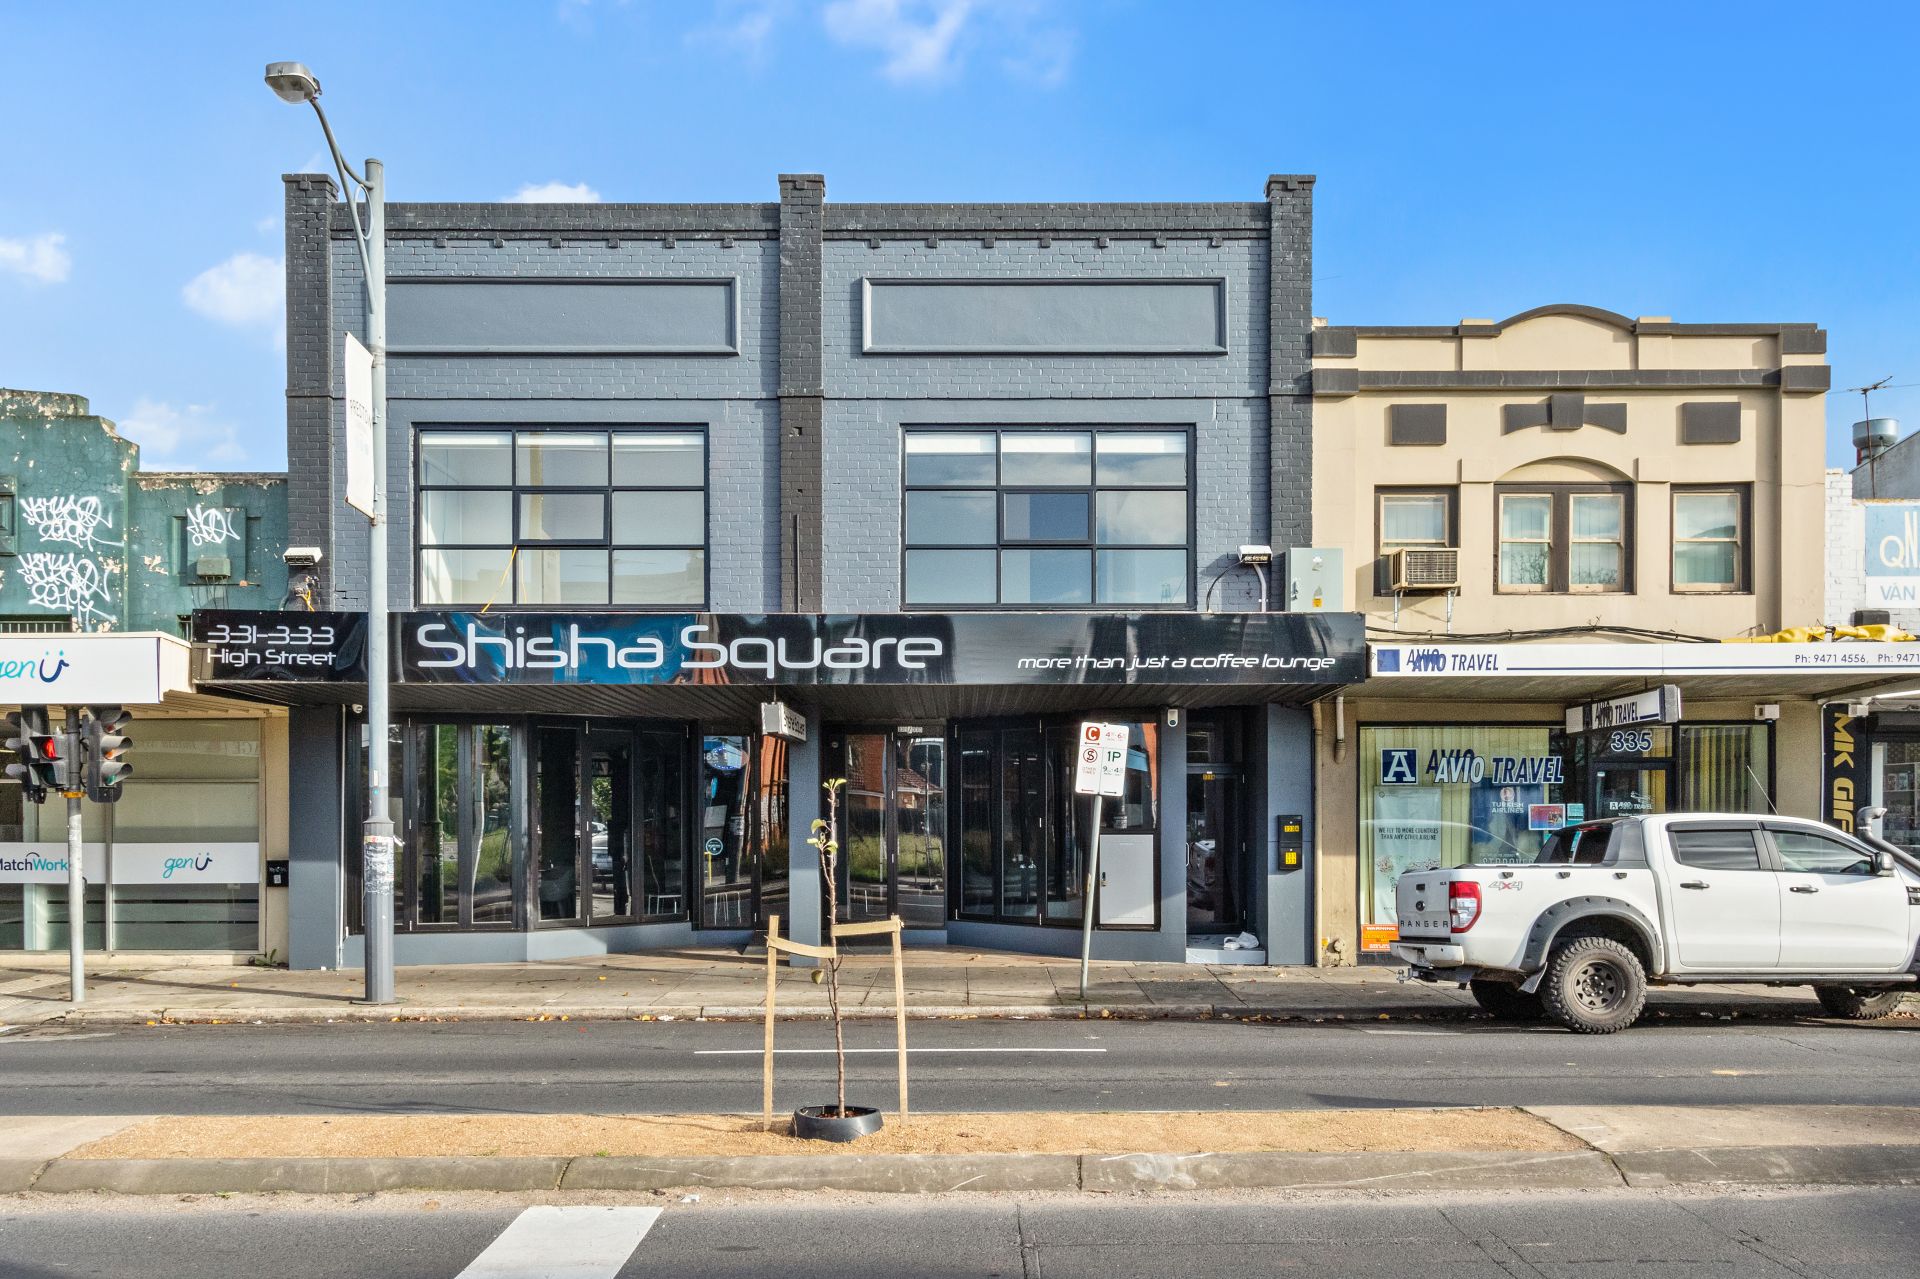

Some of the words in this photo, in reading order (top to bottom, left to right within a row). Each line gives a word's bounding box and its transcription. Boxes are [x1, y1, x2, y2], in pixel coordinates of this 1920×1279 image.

[1880, 511, 1920, 568] QN
[207, 625, 335, 645] 331-333
[207, 648, 261, 667] High
[265, 649, 337, 666] Street
[417, 624, 664, 668] Shisha
[680, 624, 942, 678] Square
[1795, 654, 1811, 664] Ph:
[1814, 654, 1837, 663] 9471
[1878, 653, 1893, 663] Ph:
[1897, 653, 1919, 663] 9471
[1017, 656, 1071, 669] more
[1075, 655, 1125, 669] than
[1127, 655, 1170, 671] just
[1172, 656, 1187, 669] a
[1190, 654, 1259, 669] coffee
[1262, 654, 1336, 671] lounge
[1451, 654, 1499, 671] TRAVEL
[1614, 702, 1639, 725] TRAVEL
[1611, 730, 1653, 752] 335
[1834, 712, 1854, 769] MK
[1107, 751, 1122, 762] 1P
[1426, 748, 1486, 783] AVIO
[1492, 756, 1565, 784] TRAVEL
[1383, 751, 1416, 782] A
[0, 858, 69, 871] atchWork
[1400, 919, 1449, 928] RANGER
